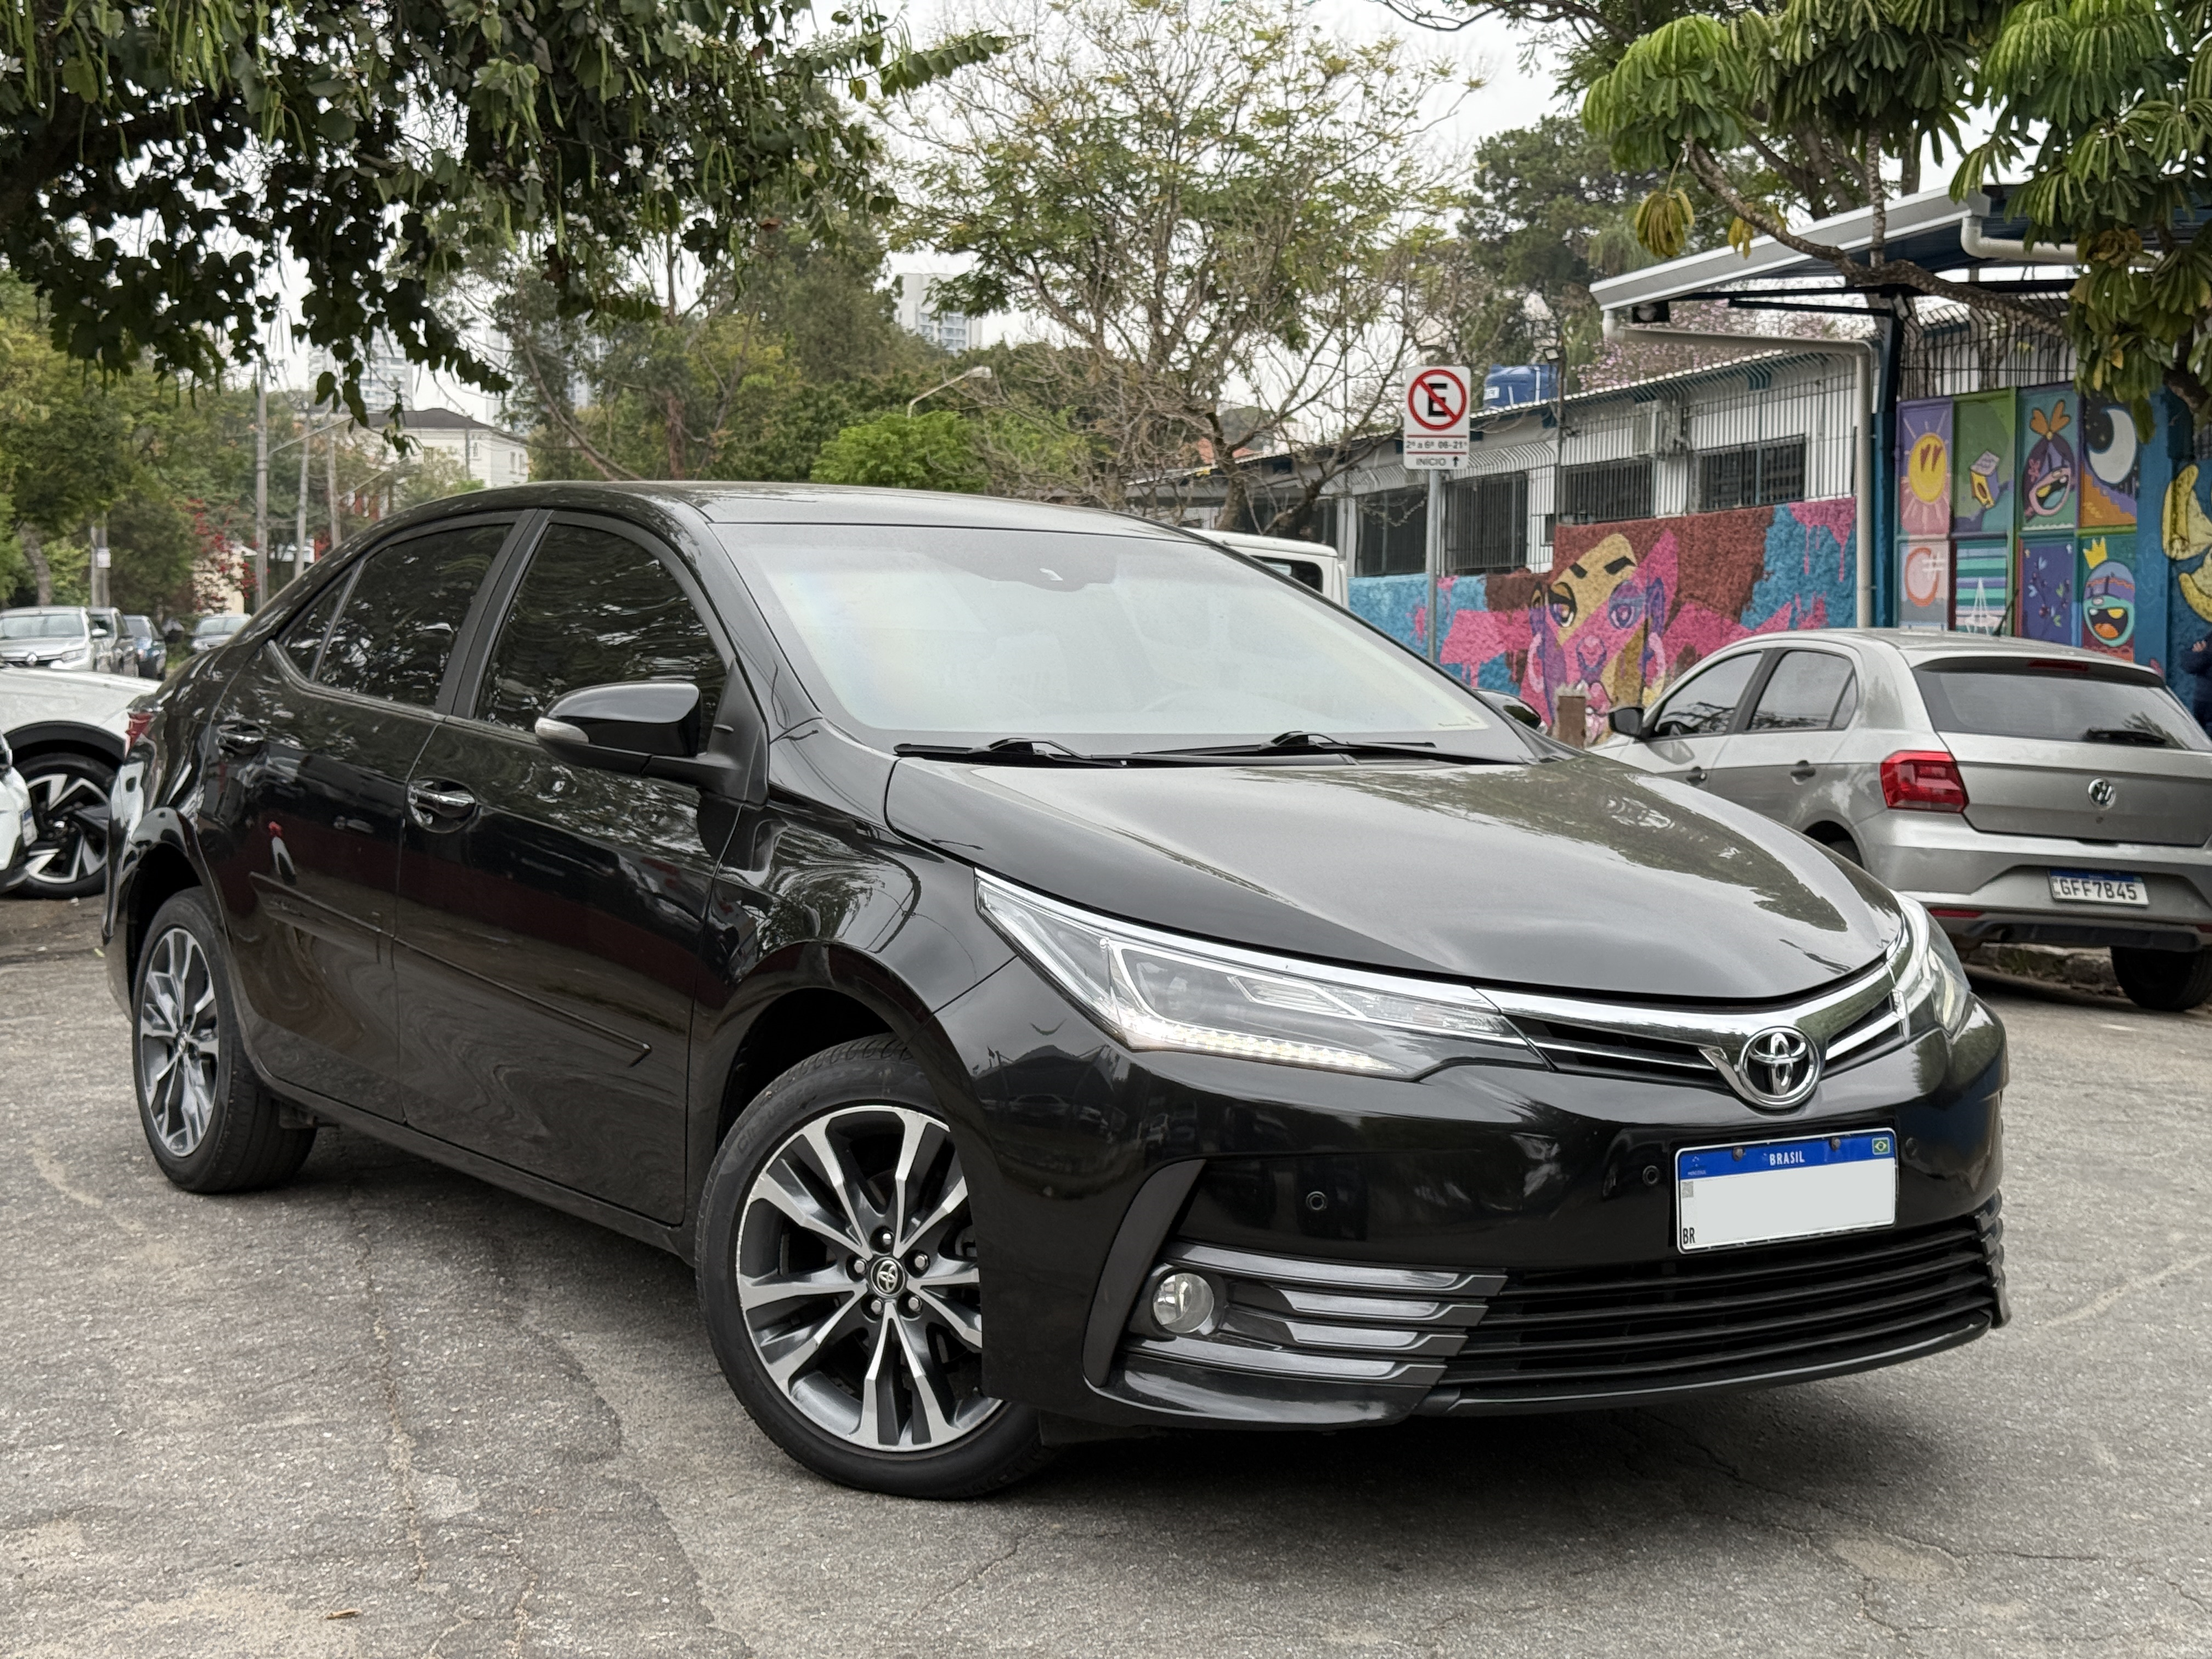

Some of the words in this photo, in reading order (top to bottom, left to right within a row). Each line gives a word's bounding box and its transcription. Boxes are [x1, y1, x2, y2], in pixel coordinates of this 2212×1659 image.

[1427, 383, 1448, 417] E
[2059, 878, 2138, 901] GFF7B45
[1769, 1150, 1805, 1166] BRASIL
[1683, 1226, 1696, 1244] BR
